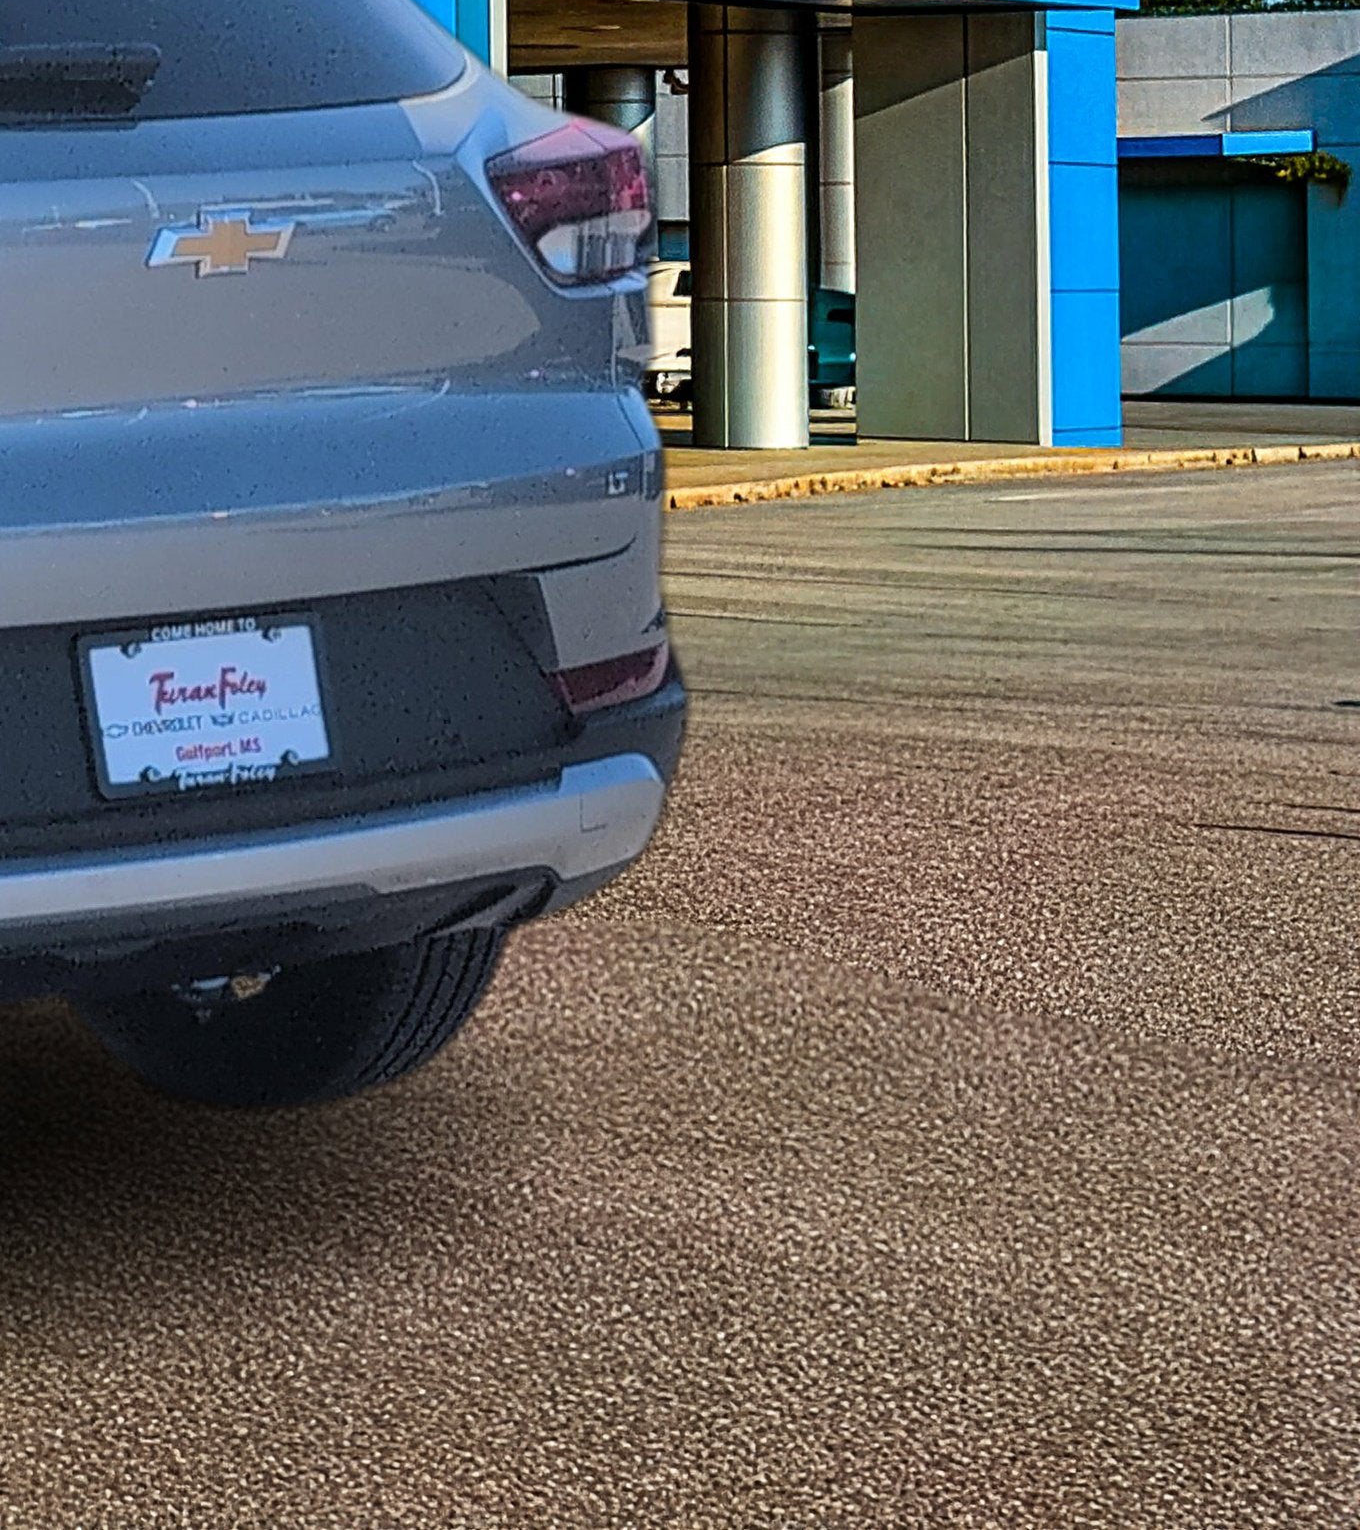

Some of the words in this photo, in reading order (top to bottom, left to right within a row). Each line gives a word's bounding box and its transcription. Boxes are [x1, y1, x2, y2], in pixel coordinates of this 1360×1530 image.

[151, 624, 192, 642] COME
[194, 619, 233, 637] HOME
[238, 617, 257, 632] TO
[237, 704, 322, 725] CADILLAC
[239, 737, 262, 754] MS
